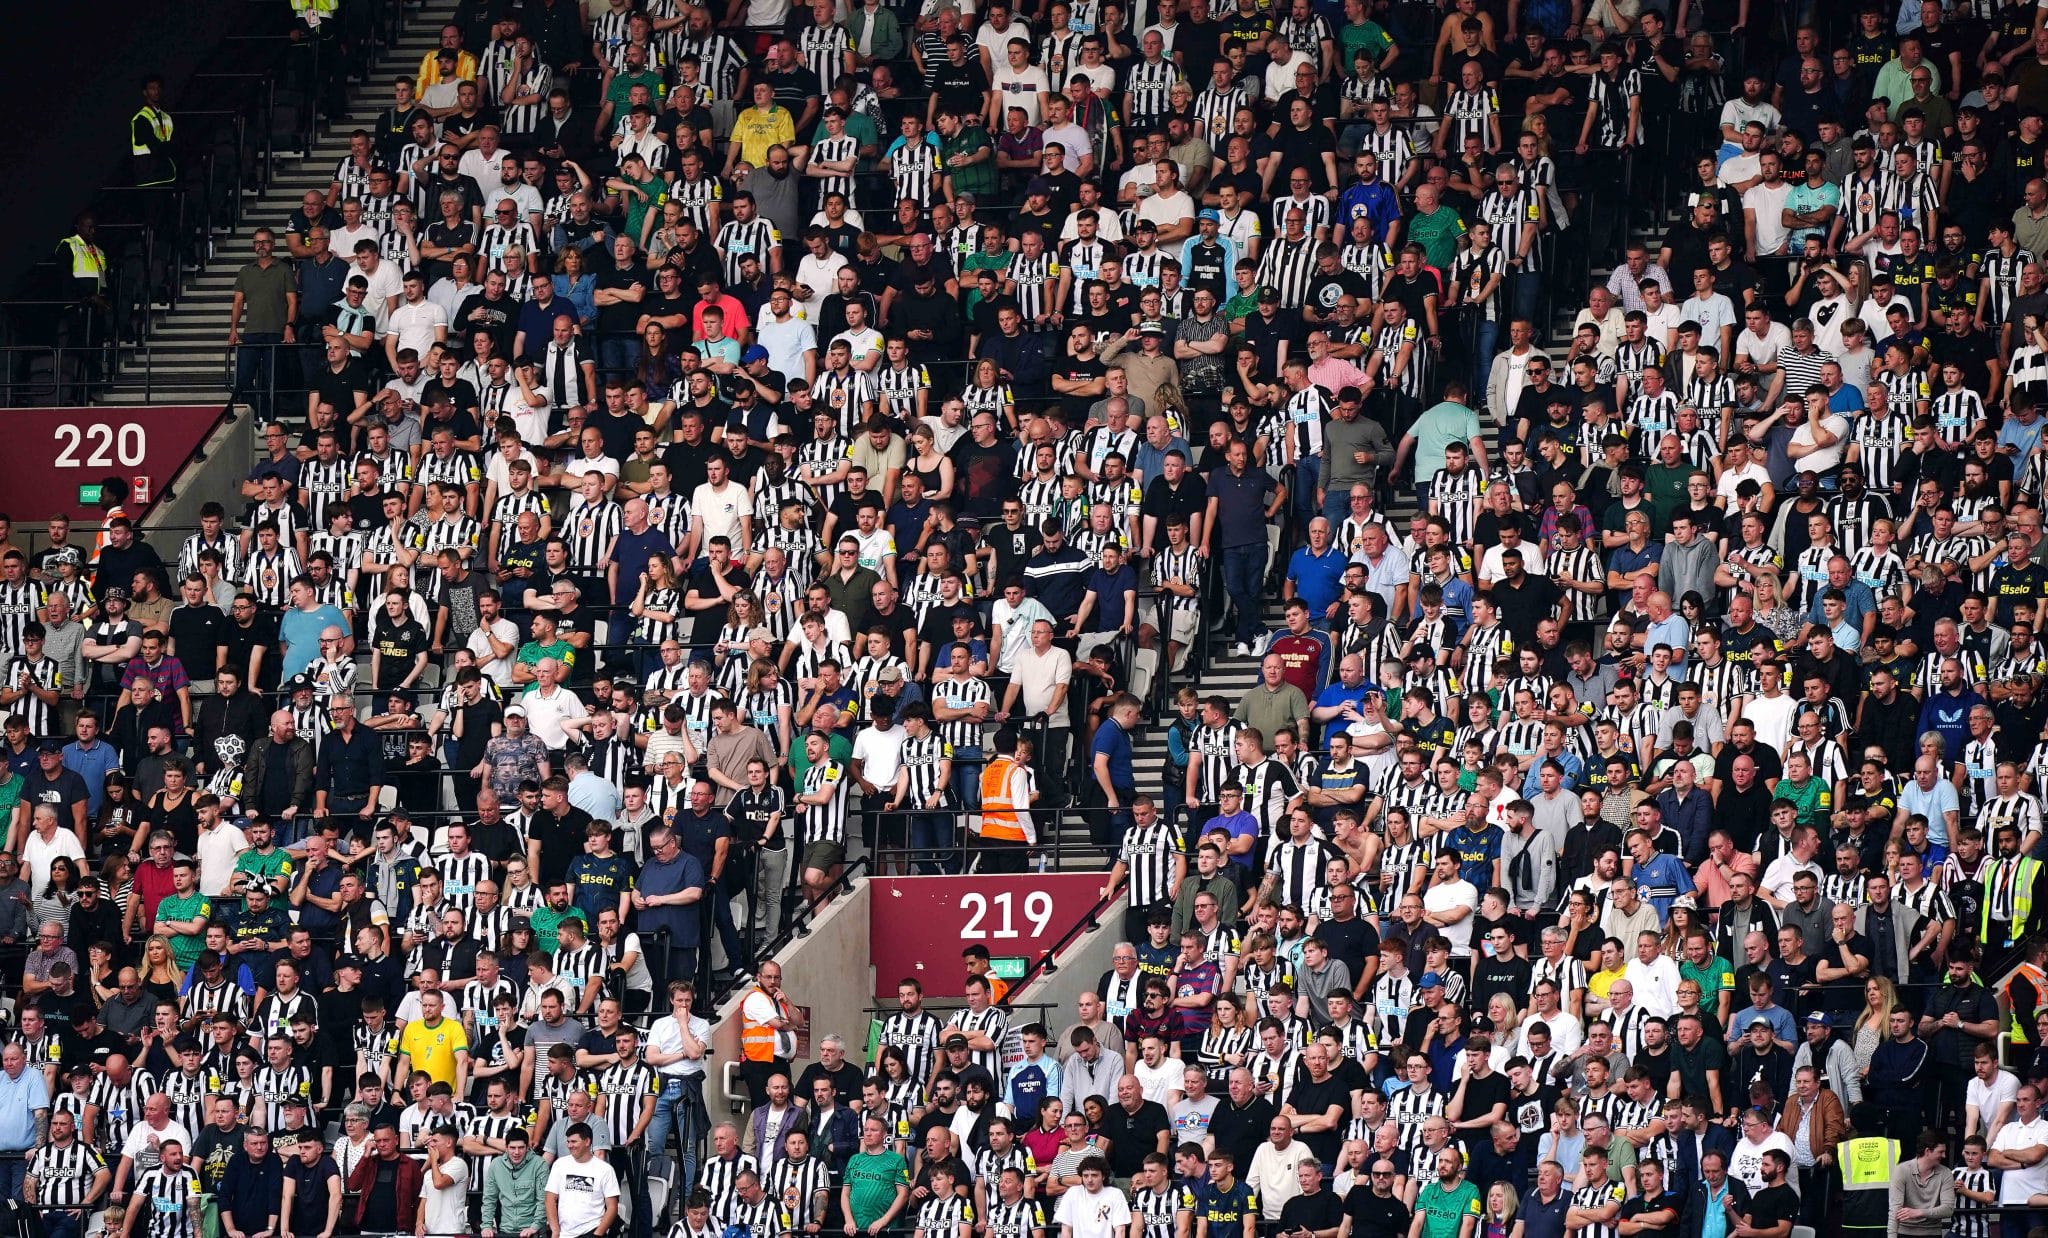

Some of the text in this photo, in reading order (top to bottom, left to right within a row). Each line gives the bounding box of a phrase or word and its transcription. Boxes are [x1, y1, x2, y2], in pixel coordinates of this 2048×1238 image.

[815, 42, 833, 50] sela
[1145, 81, 1163, 89] sela
[1779, 171, 1806, 179] CELINE
[371, 211, 390, 219] sela
[1903, 275, 1918, 285] sela
[894, 389, 913, 398] sela
[1894, 394, 1911, 402] sela
[977, 401, 995, 409] sela
[54, 423, 145, 468] 220
[1874, 439, 1893, 447] sela
[820, 460, 836, 468] sela
[322, 483, 339, 491] sela
[1448, 492, 1467, 501] sela
[1034, 505, 1052, 513] sela
[787, 542, 805, 550] sela
[2010, 584, 2030, 594] sela
[10, 605, 28, 613] sela
[380, 648, 408, 657] FUN88
[1470, 646, 1486, 654] sela
[1281, 653, 1310, 661] northern
[295, 729, 314, 738] sela
[915, 755, 932, 765] sela
[1134, 844, 1154, 853] sela
[1462, 852, 1484, 862] sela
[590, 875, 614, 886] sela
[959, 891, 1053, 938] 219
[1147, 965, 1170, 975] sela
[901, 1034, 922, 1044] sela
[614, 1084, 635, 1094] sela
[181, 1093, 200, 1103] sela
[52, 1168, 74, 1177] sela
[860, 1171, 881, 1181] sela
[1152, 1214, 1172, 1224] sela
[933, 1219, 951, 1229] sela
[999, 1224, 1018, 1234] sela
